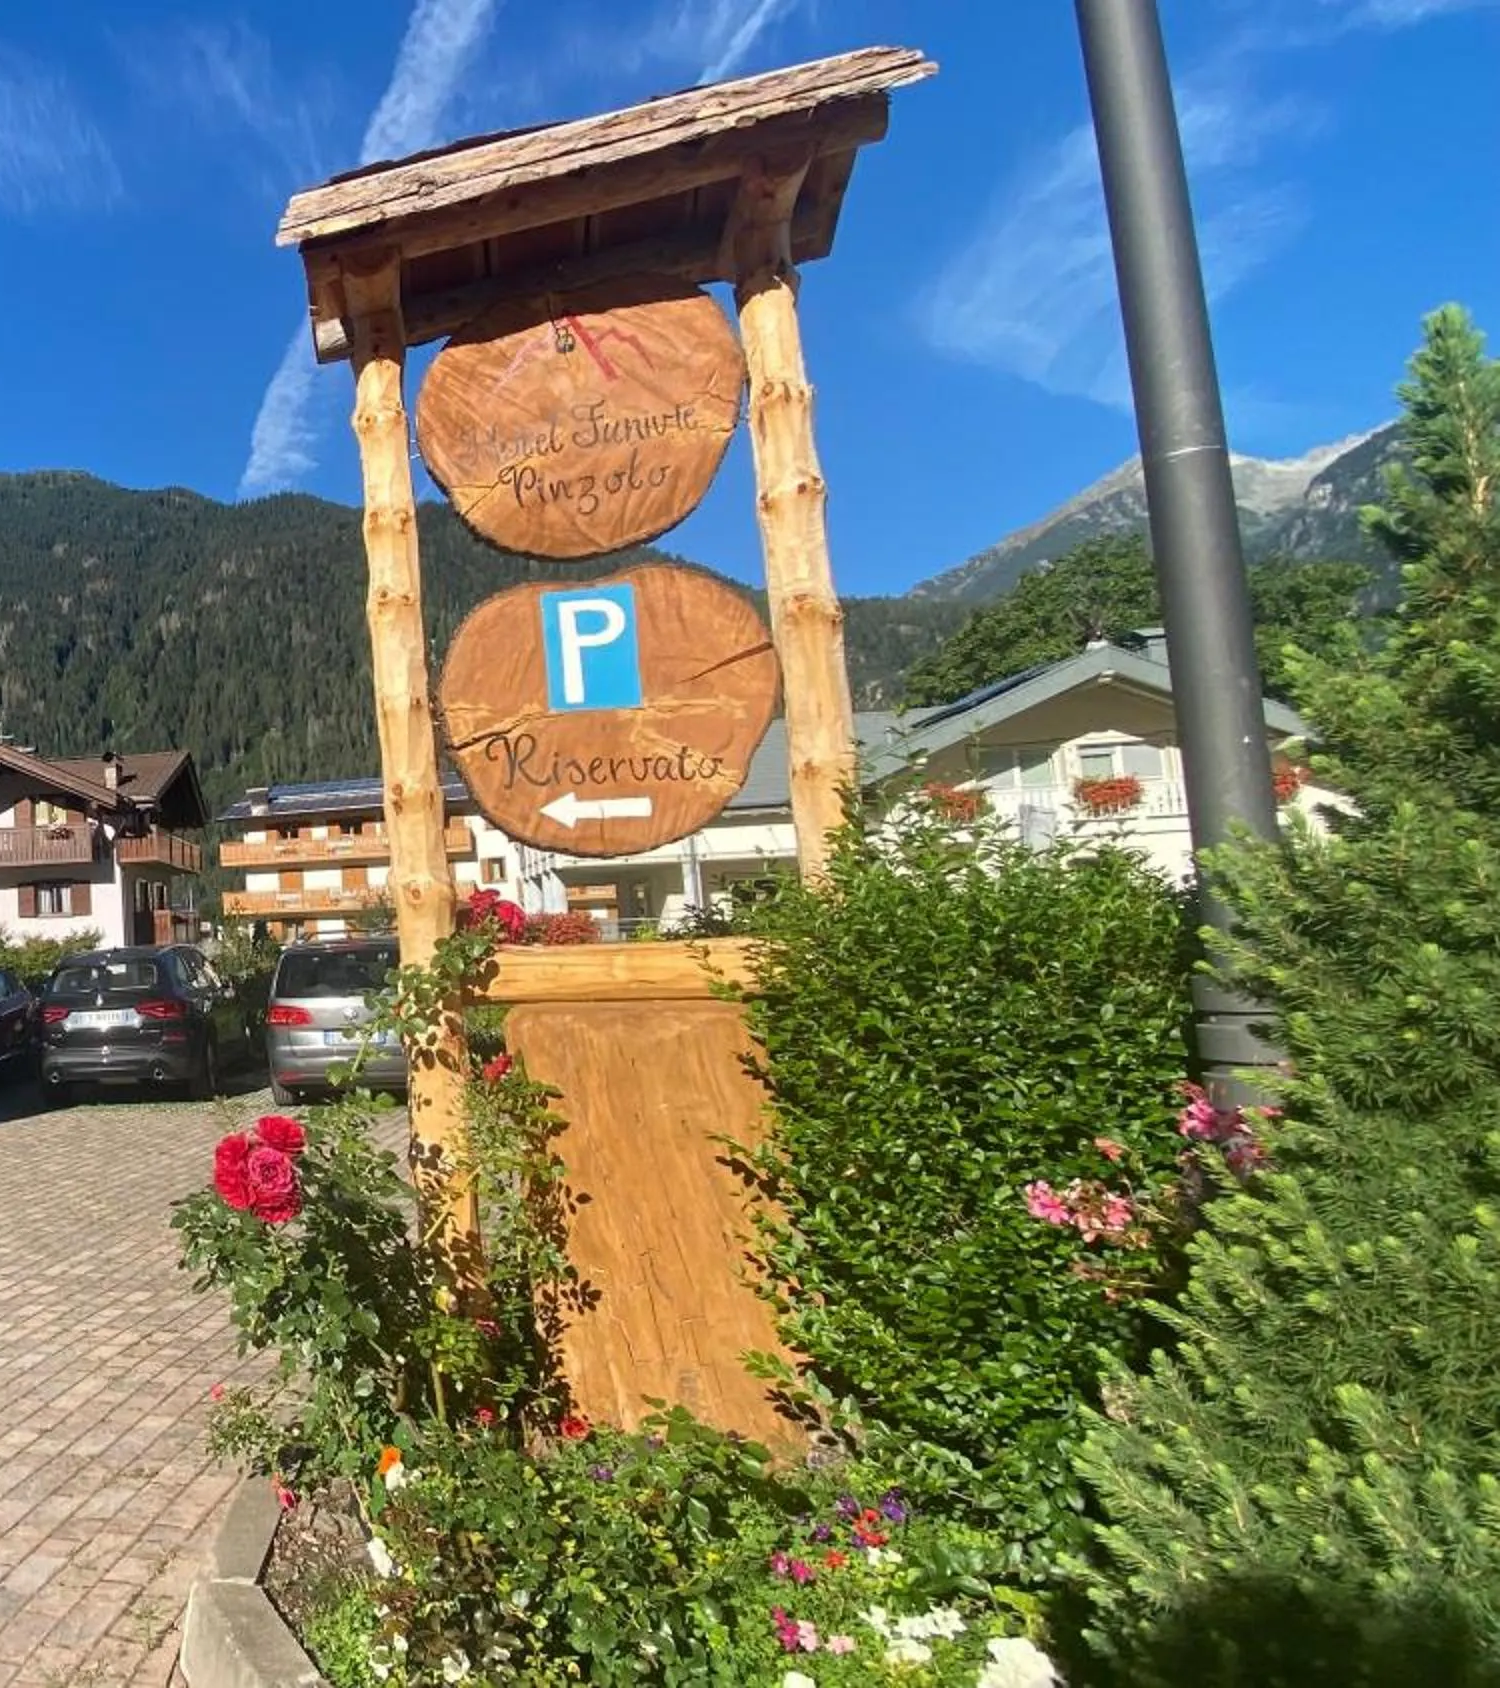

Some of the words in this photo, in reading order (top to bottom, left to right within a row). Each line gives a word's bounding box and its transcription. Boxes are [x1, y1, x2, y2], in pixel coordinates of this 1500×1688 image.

[498, 447, 670, 514] Pinzolo
[557, 599, 625, 704] P
[485, 733, 723, 790] Riservato
